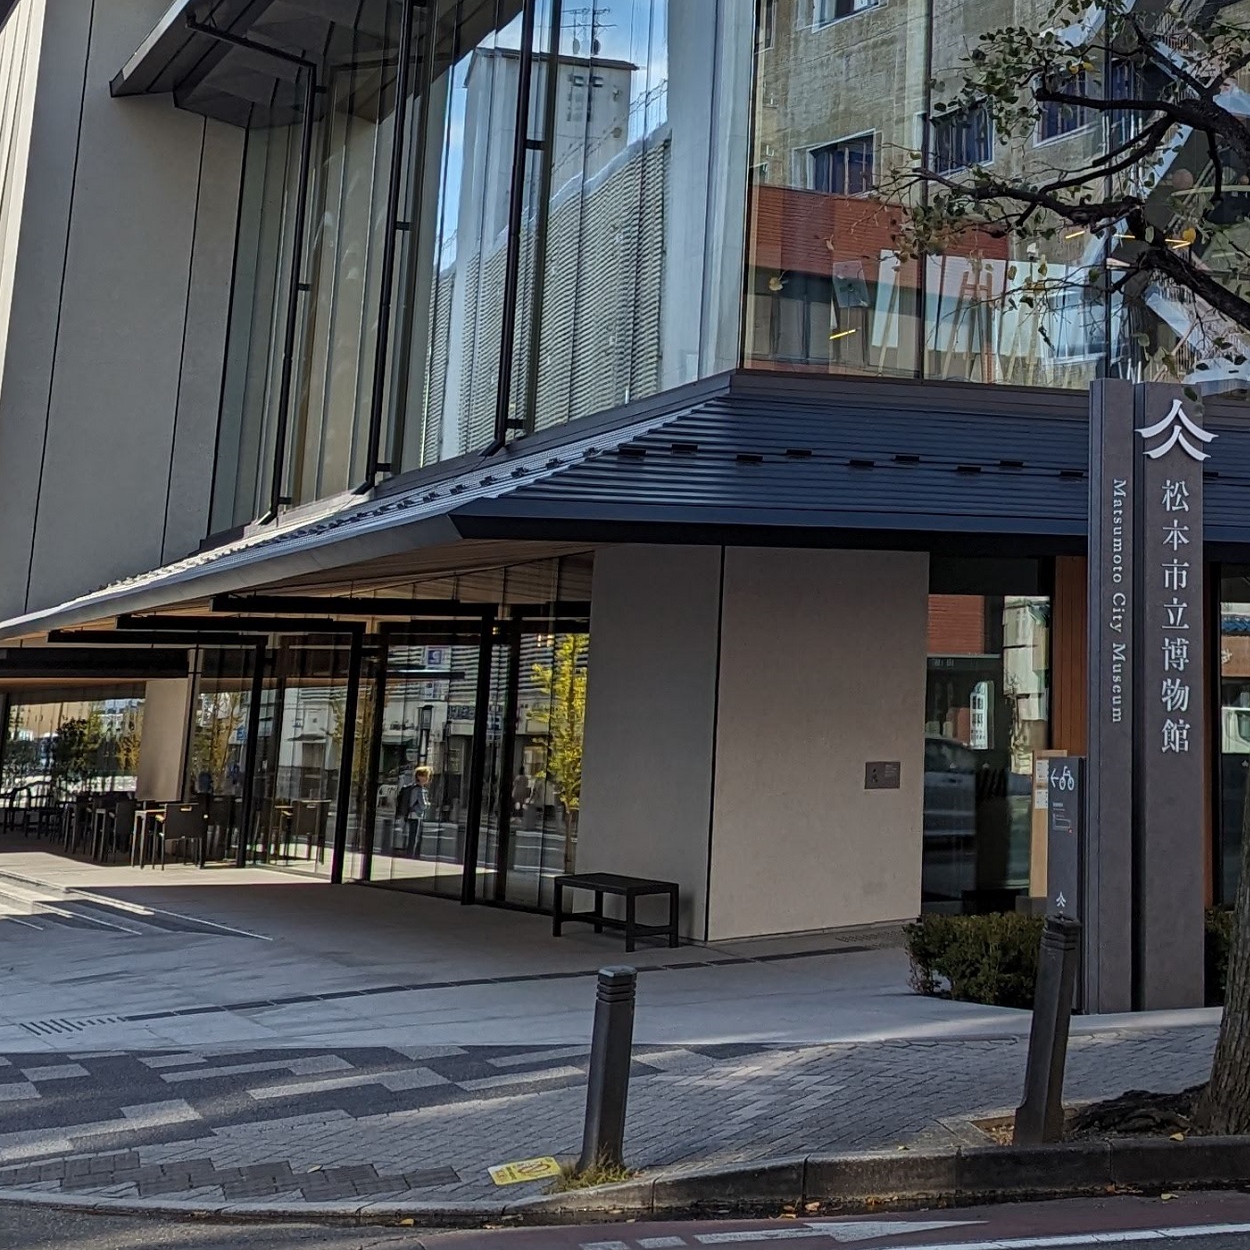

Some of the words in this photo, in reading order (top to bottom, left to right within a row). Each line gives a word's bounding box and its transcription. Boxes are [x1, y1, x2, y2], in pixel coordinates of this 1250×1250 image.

[1112, 478, 1127, 583] Matsumoto
[1110, 592, 1126, 633] City
[1161, 479, 1190, 753] 松本市立博物館
[1112, 642, 1126, 723] Museum
